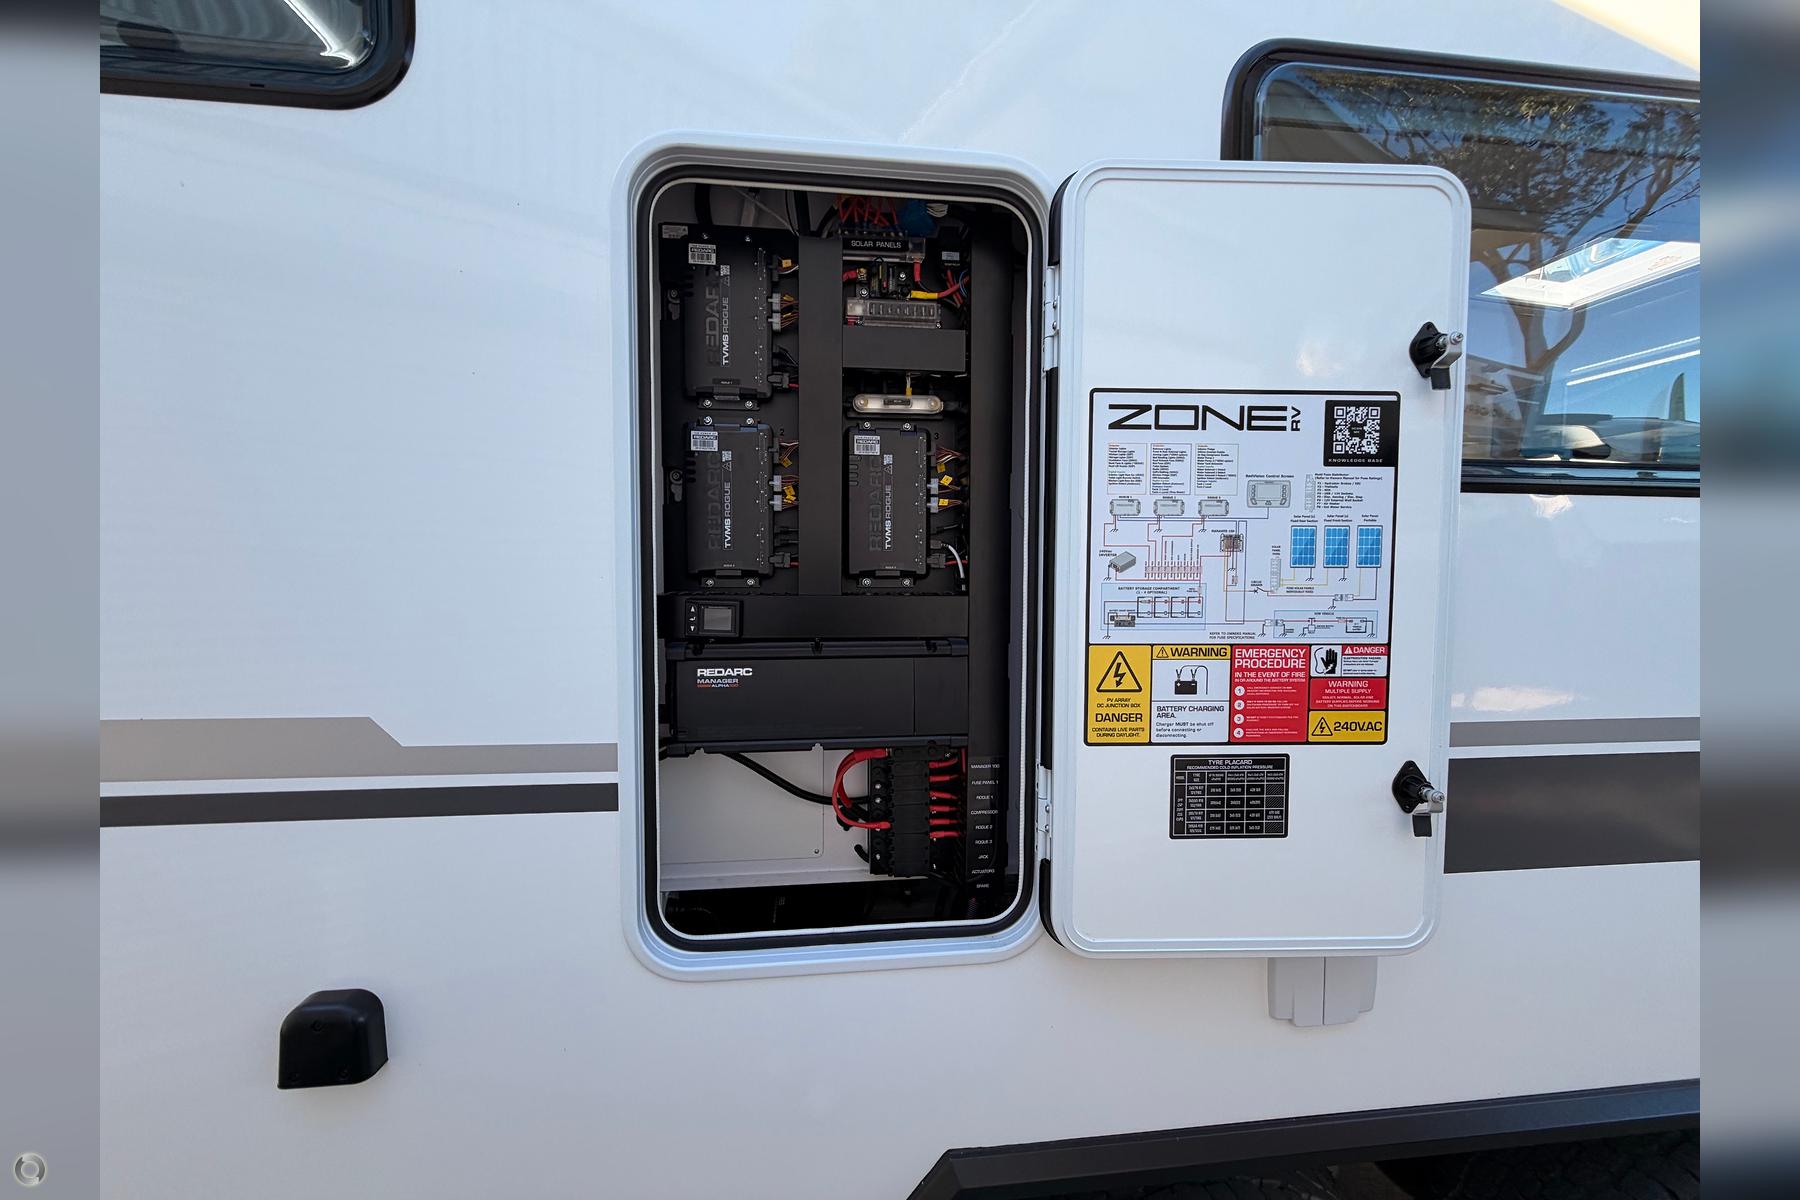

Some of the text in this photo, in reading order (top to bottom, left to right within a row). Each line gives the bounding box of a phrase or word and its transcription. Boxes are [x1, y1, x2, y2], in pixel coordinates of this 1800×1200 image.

[1108, 404, 1287, 431] ZONE
[1291, 406, 1301, 431] RV
[1171, 648, 1227, 656] WARNING
[1236, 649, 1306, 658] EMERGENCY
[1235, 659, 1306, 668] PROCEDURE
[697, 668, 752, 676] REDARC
[1096, 713, 1142, 722] DANGER
